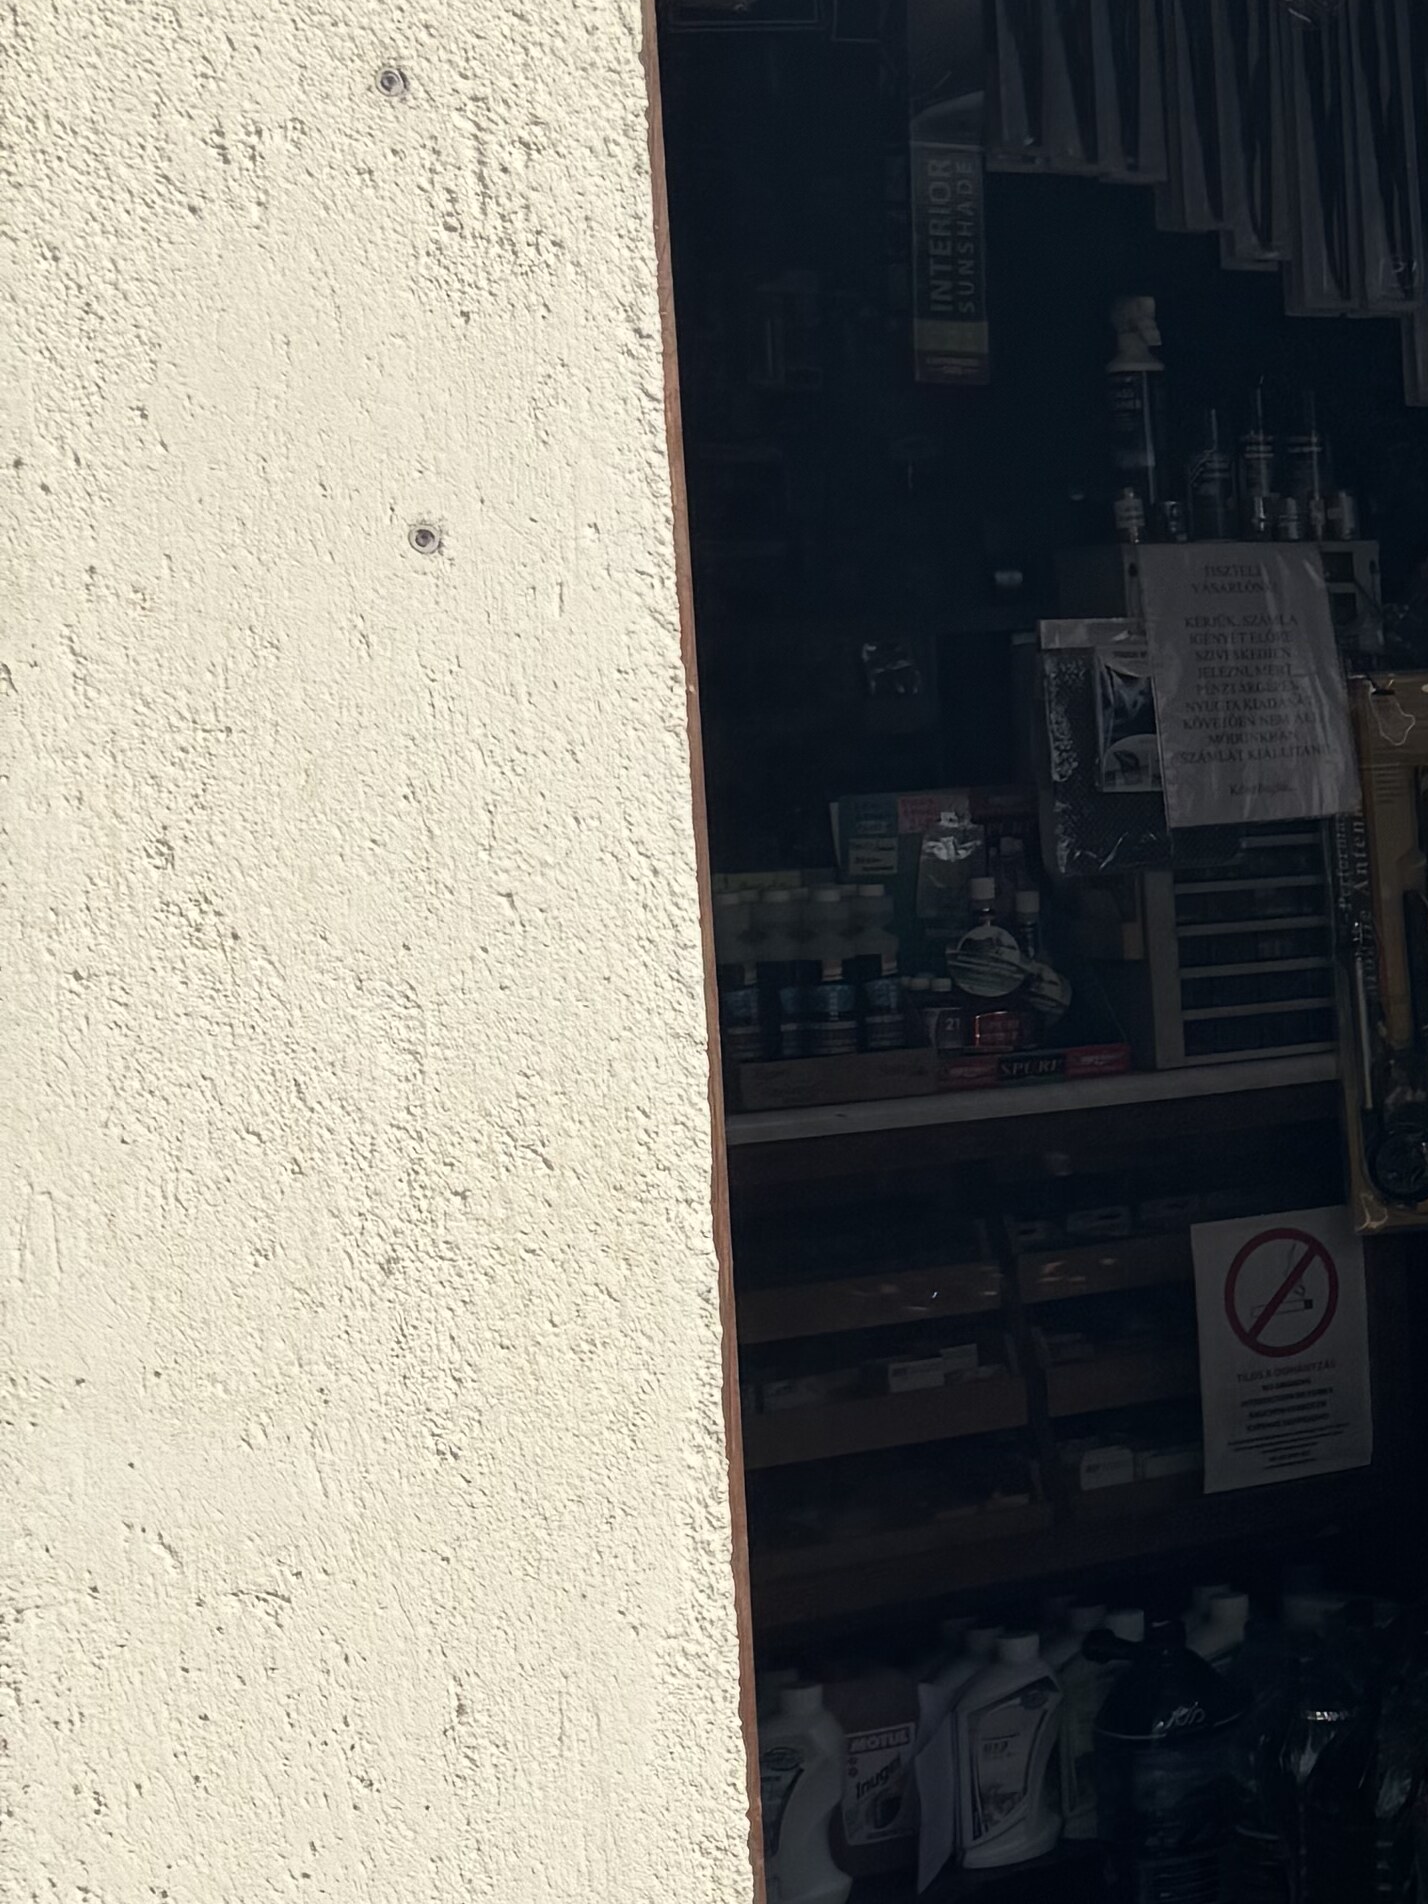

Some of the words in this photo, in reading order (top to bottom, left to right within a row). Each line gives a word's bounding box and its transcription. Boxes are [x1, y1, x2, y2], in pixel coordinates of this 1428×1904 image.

[928, 159, 952, 312] INTERIOR
[956, 160, 975, 313] SUNSHADE
[851, 1727, 909, 1752] MOTUL
